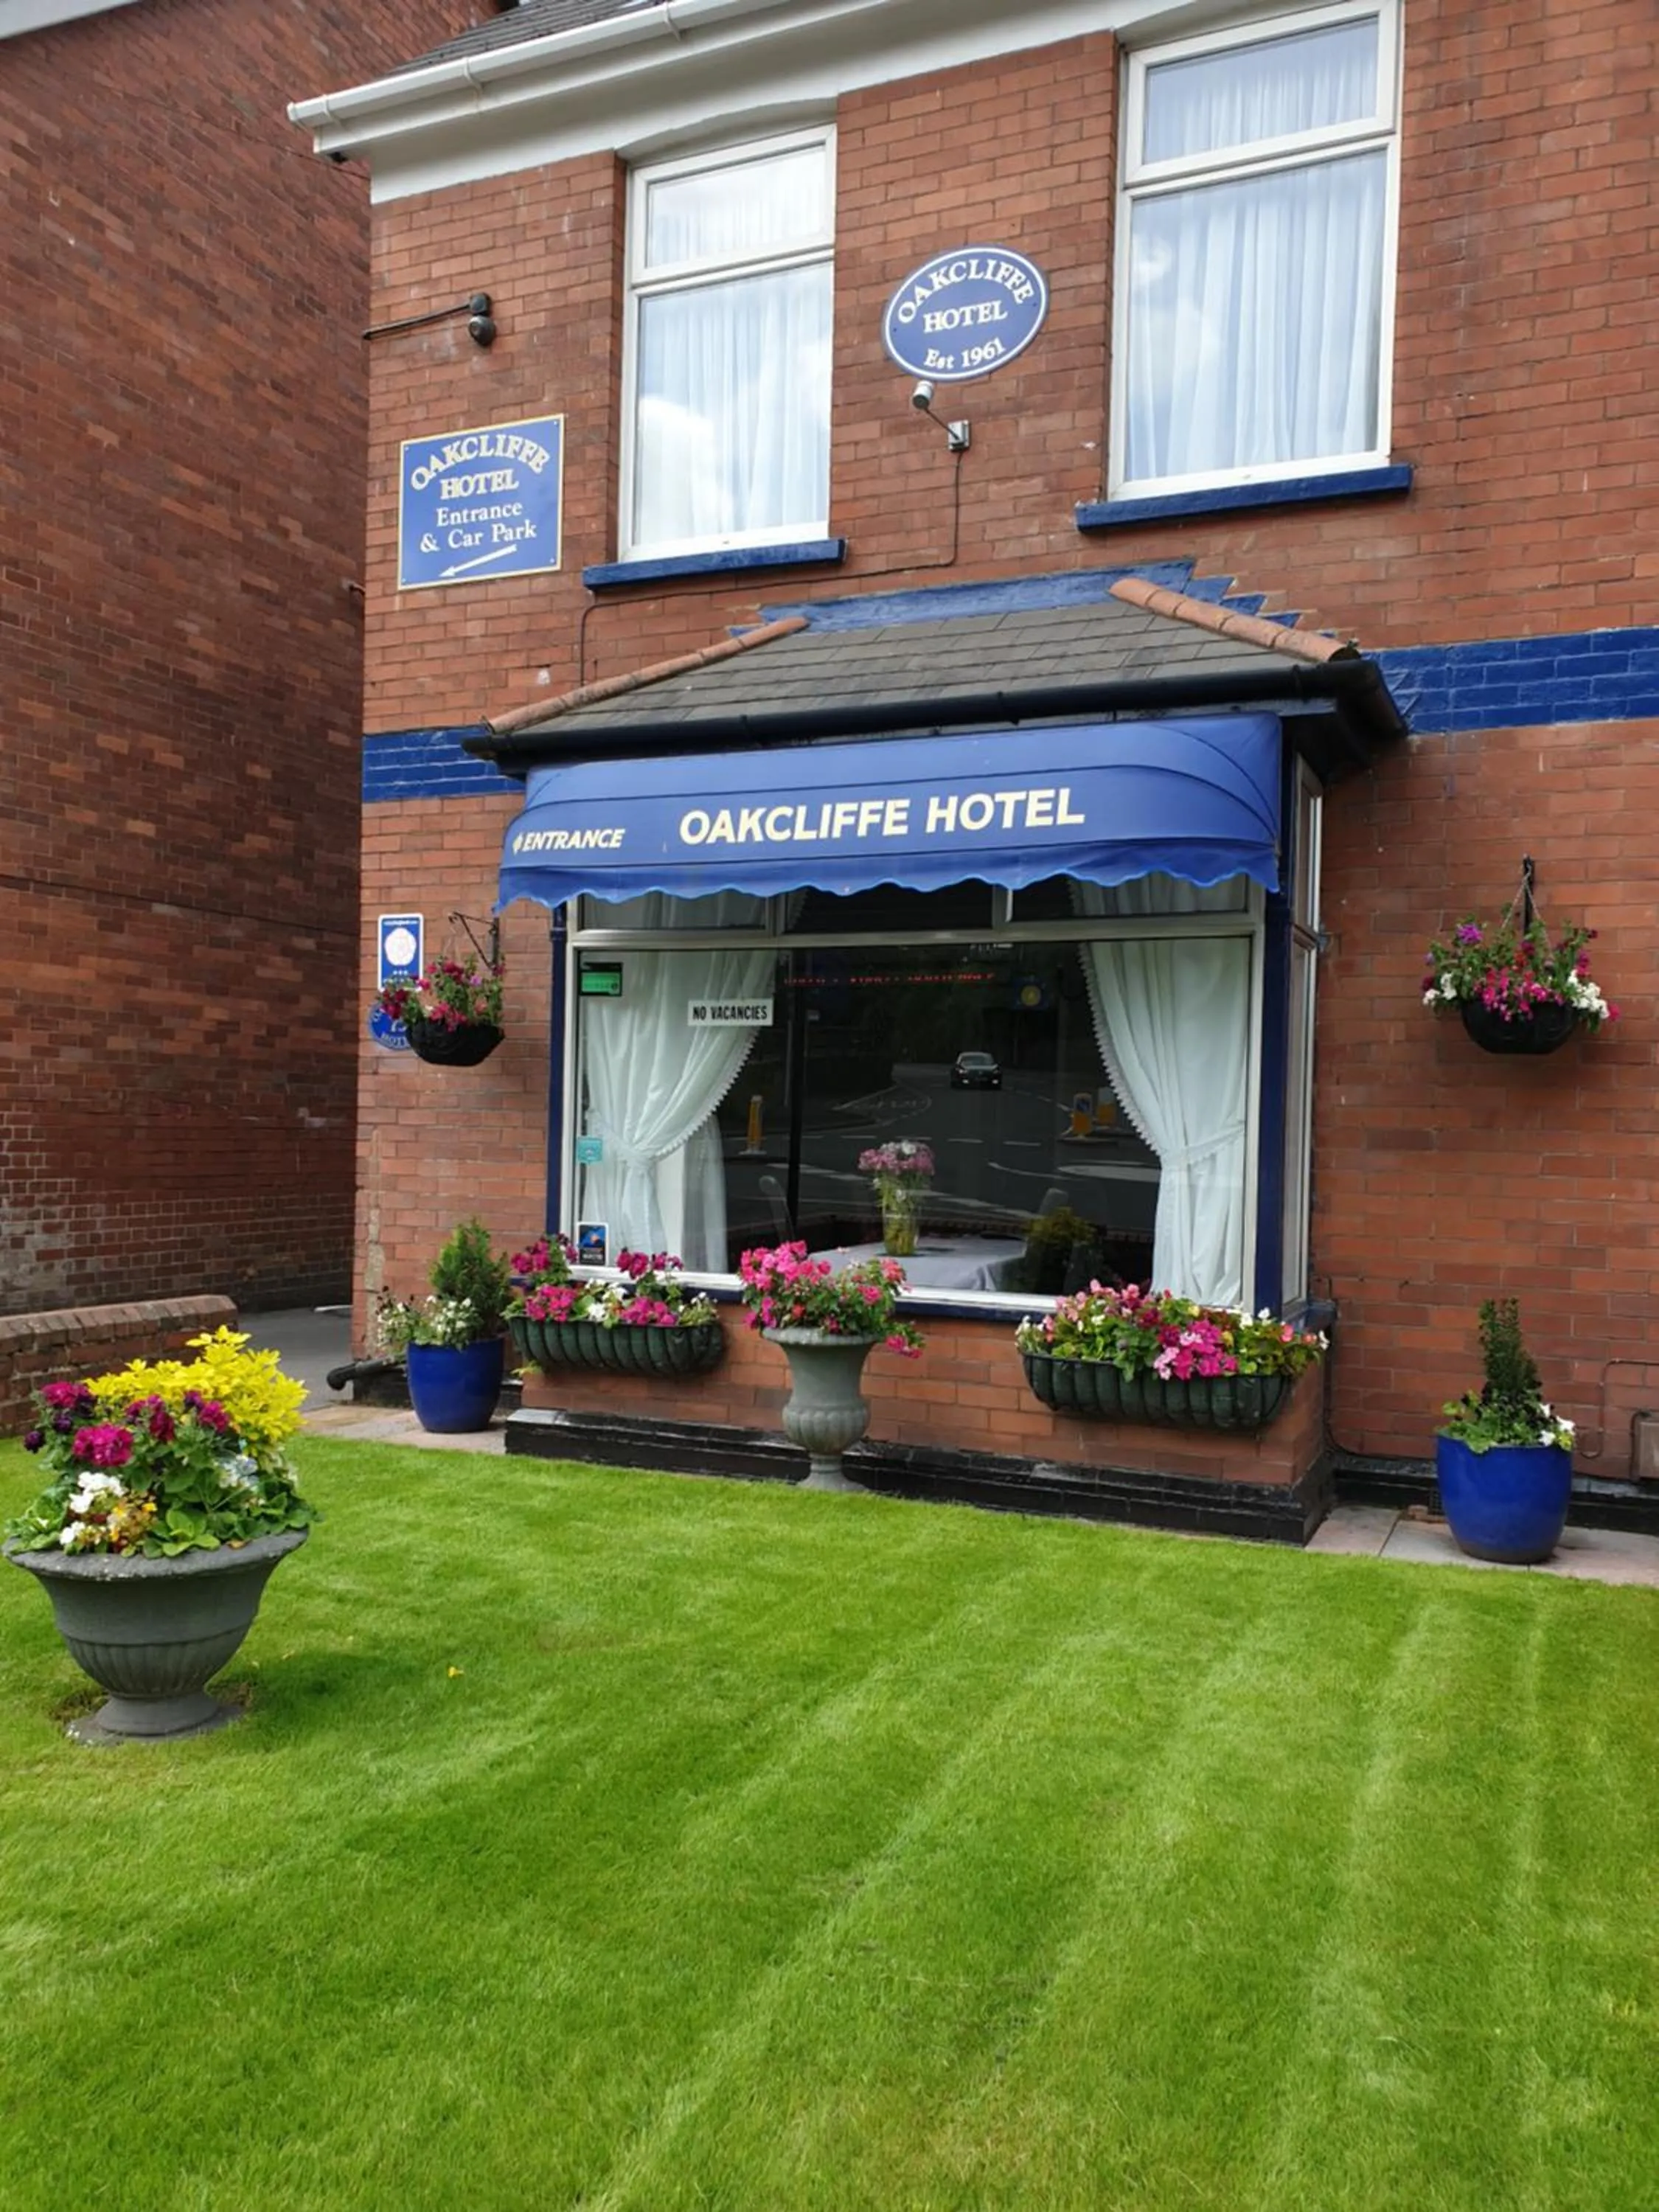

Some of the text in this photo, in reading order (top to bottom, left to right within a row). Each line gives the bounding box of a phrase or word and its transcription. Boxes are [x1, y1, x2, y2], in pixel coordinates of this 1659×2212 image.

[898, 259, 1034, 323] OAKCLIFFE
[923, 300, 1008, 333] HOTEL
[923, 337, 1006, 369] Est 1961
[411, 434, 550, 490] OAKCLIFFE
[440, 469, 519, 499] HOTEL
[437, 502, 523, 527] Entrance
[420, 519, 537, 553] & Car Park
[679, 787, 1085, 844] OAKCLIFFE HOTEL
[522, 828, 626, 852] ENTRANCE
[692, 1005, 768, 1020] NO VACANCIES
